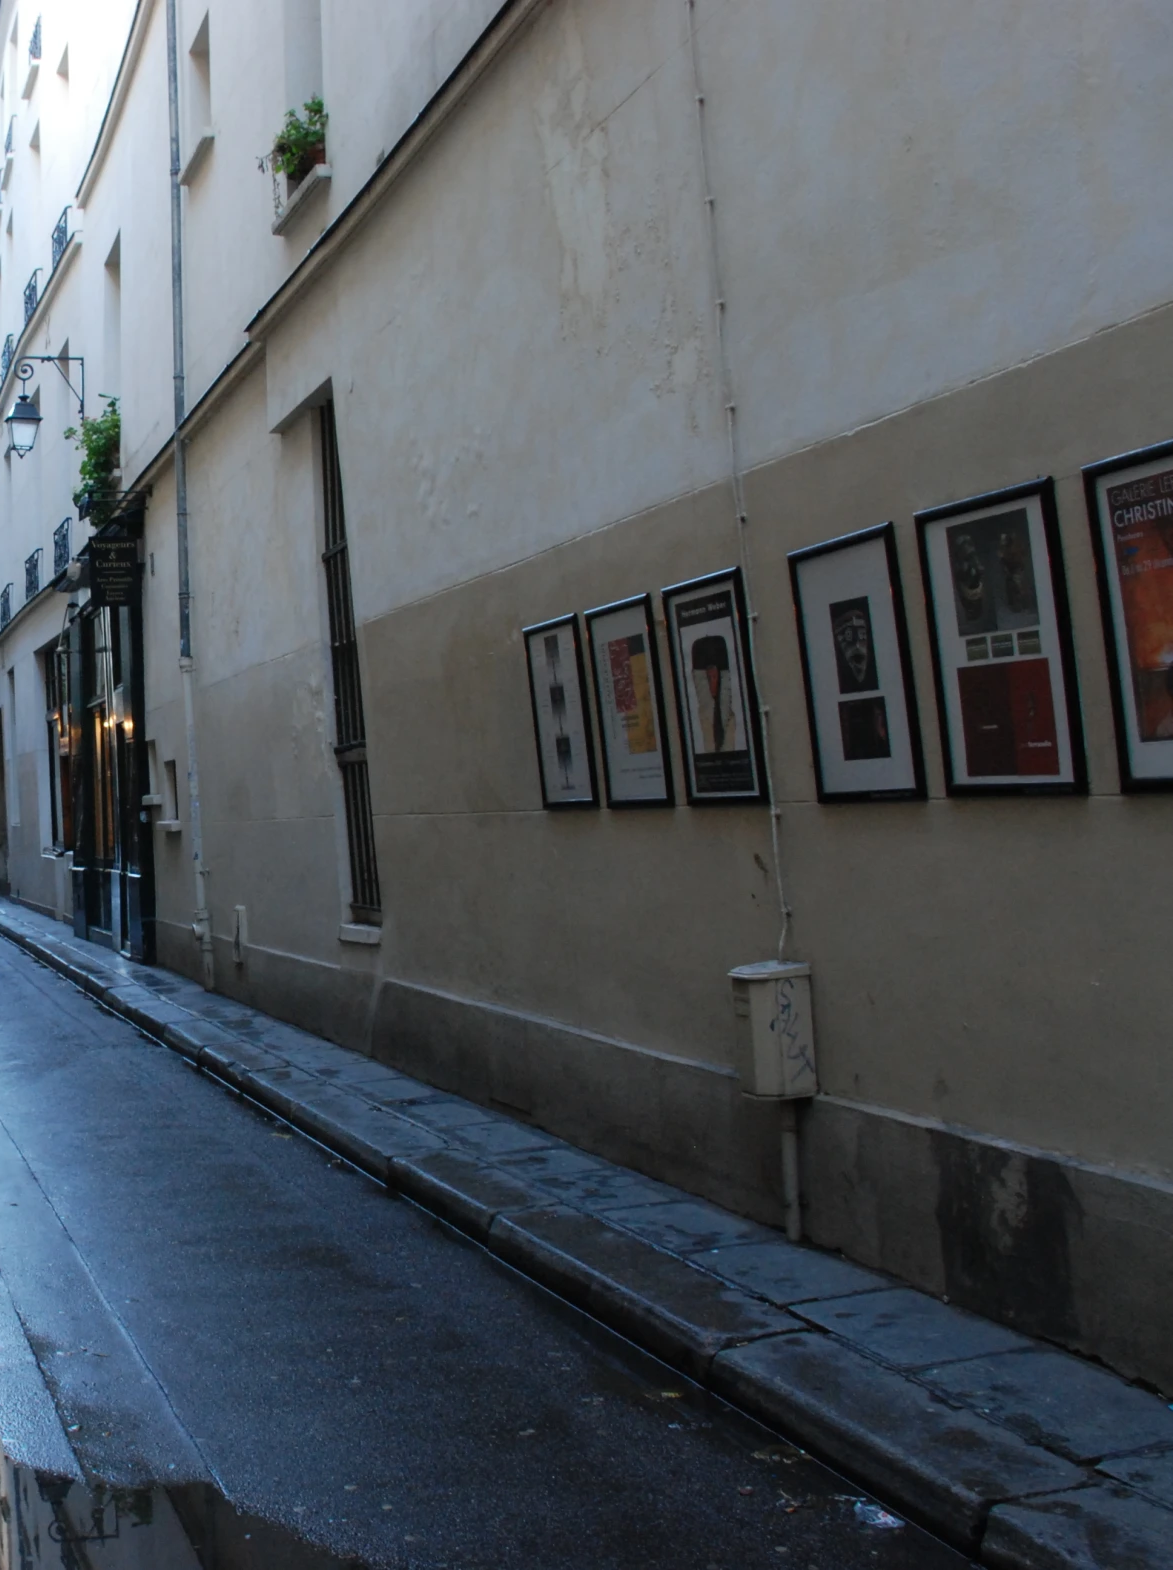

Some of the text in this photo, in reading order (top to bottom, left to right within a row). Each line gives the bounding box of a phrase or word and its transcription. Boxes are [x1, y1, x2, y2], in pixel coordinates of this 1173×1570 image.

[1112, 481, 1156, 507] GALERIE
[91, 540, 135, 550] Voyageurs
[108, 551, 116, 560] &
[95, 560, 132, 568] Curieux
